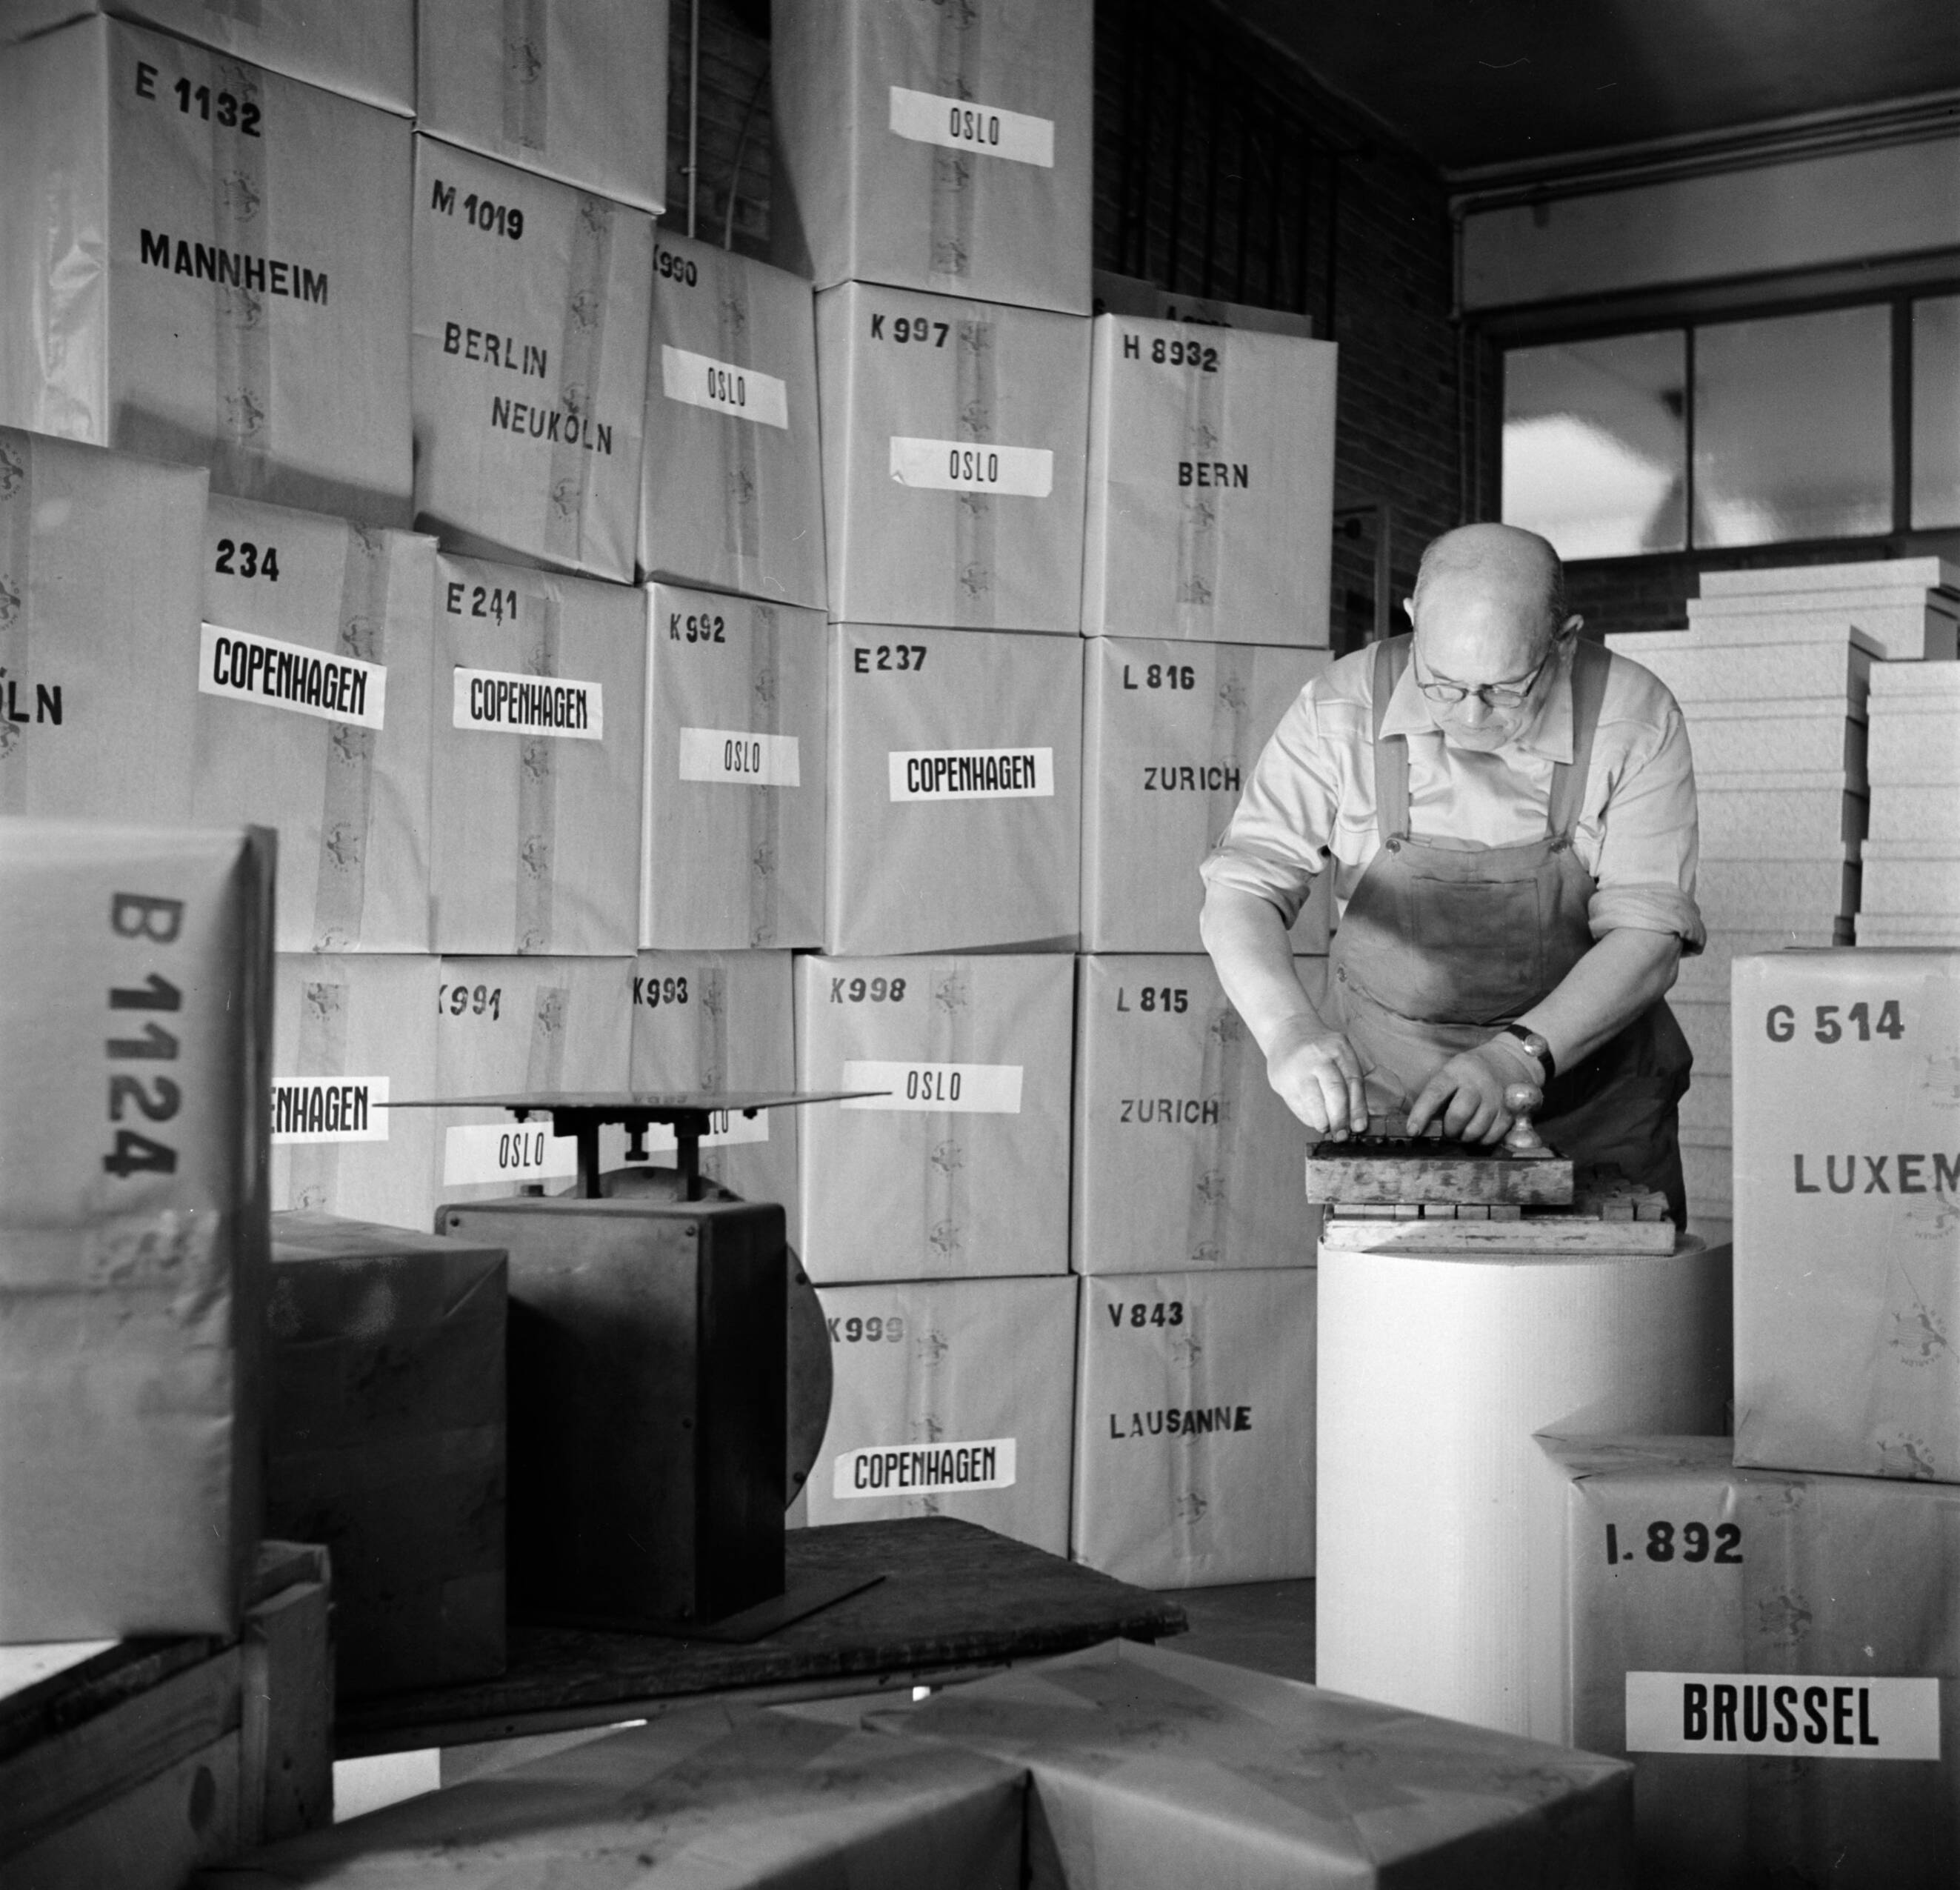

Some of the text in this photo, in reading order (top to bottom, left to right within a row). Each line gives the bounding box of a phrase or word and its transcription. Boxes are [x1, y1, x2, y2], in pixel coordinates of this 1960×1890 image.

[174, 77, 261, 138] 1132
[950, 107, 999, 146] OSLO
[464, 193, 524, 241] 1019
[140, 228, 327, 305] MANNHEIM
[443, 321, 547, 379] BERLIN
[1124, 334, 1219, 373] H 8932
[707, 367, 746, 407] OSLO
[950, 449, 998, 483] OSLO
[1179, 462, 1248, 488] BERN
[215, 538, 279, 582] 234
[213, 636, 368, 716] COPENHAGEN
[470, 677, 588, 730] COPENHAGEN
[724, 739, 761, 774] OSLO
[906, 755, 1036, 793] COPENHAGEN
[1144, 766, 1241, 792] ZURICH
[1766, 999, 1905, 1045] G 514
[907, 1070, 961, 1102] OSLO
[1120, 1099, 1219, 1125] ZURICH
[499, 1131, 544, 1169] OSLO
[1110, 1405, 1253, 1440] LAUSANNE
[854, 1445, 996, 1490] COPENHAGEN
[1645, 1520, 1744, 1565] 892
[1683, 1682, 1880, 1747] BRUSSEL
